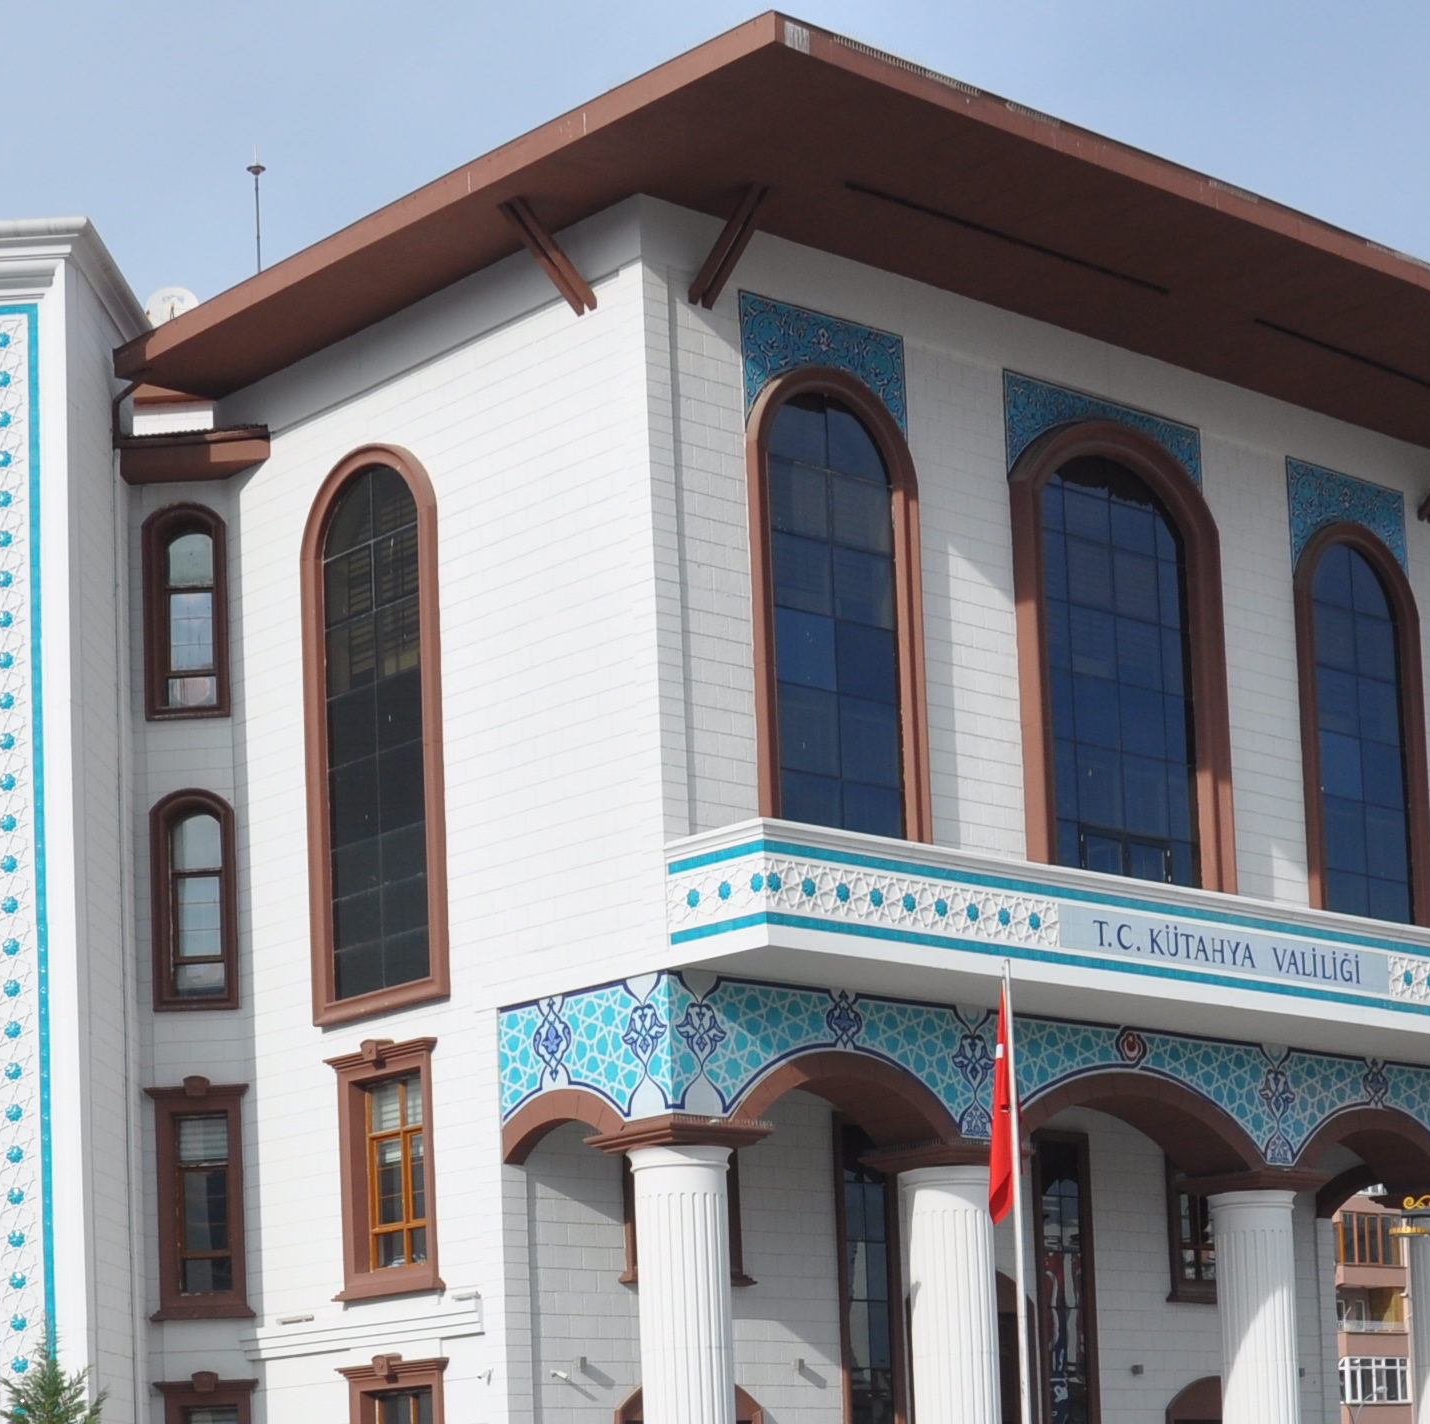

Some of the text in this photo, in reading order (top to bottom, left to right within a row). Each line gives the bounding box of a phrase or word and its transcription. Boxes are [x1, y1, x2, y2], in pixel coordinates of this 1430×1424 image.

[1092, 919, 1362, 985] T.C. KÜTAHYA VALİLİĞİ
